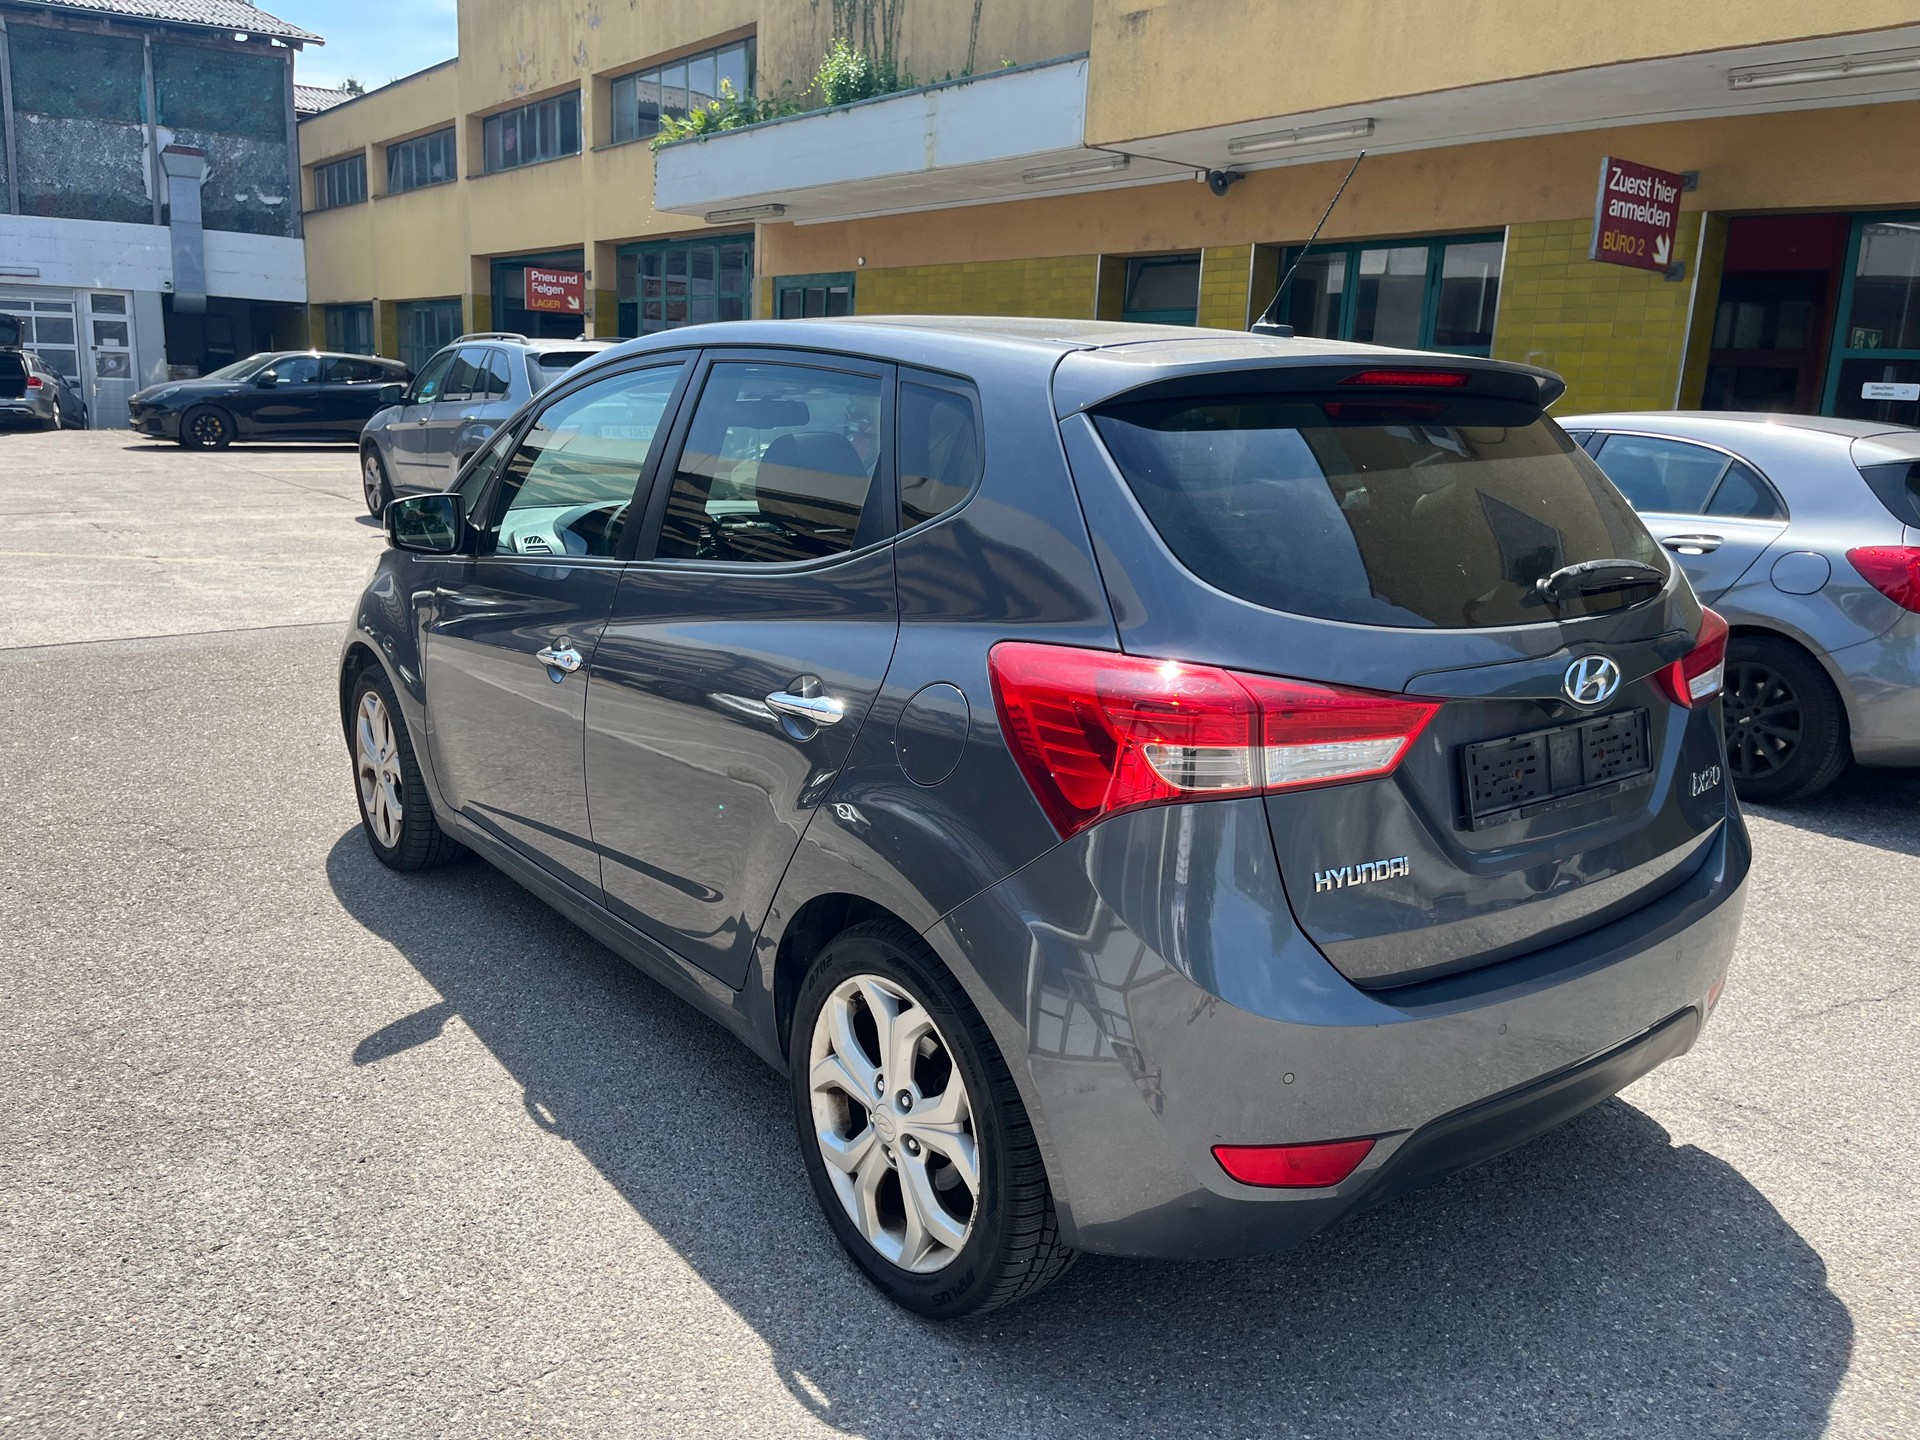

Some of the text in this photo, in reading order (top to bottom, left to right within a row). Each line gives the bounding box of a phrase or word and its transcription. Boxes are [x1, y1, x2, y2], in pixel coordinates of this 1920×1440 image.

[1609, 167, 1677, 204] Zuerst hier
[1608, 199, 1670, 228] anmelden
[1602, 229, 1645, 256] BÜRO 2
[531, 271, 578, 285] Pneu und
[531, 282, 565, 296] Felgen
[532, 298, 561, 308] LAGER
[1690, 764, 1721, 797] ix20
[1314, 856, 1410, 893] HYUNDAI
